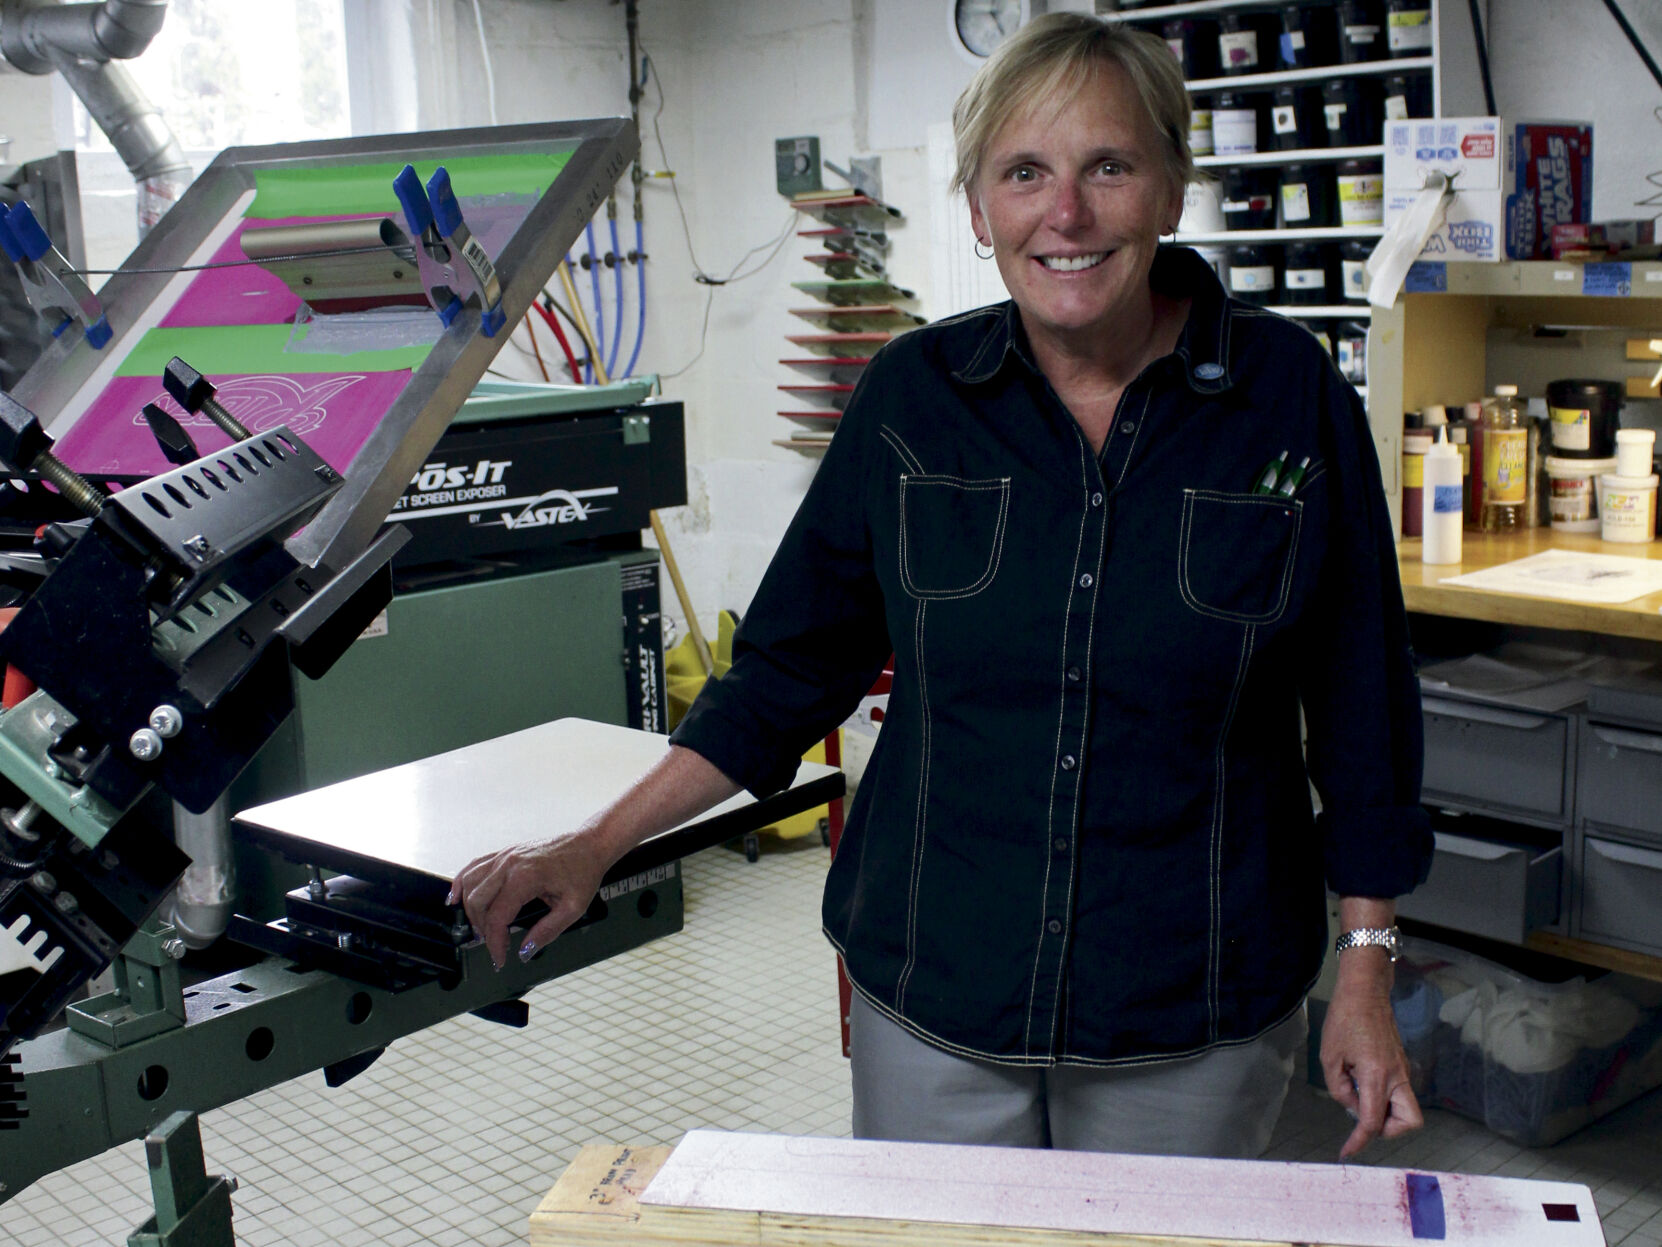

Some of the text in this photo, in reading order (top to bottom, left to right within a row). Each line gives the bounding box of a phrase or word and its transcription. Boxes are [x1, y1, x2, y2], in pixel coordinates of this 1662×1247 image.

[1547, 135, 1574, 222] RAGS
[411, 488, 455, 508] SCREEN
[457, 484, 507, 502] EXPOSER
[468, 514, 481, 524] BY
[501, 501, 590, 530] VASTEX
